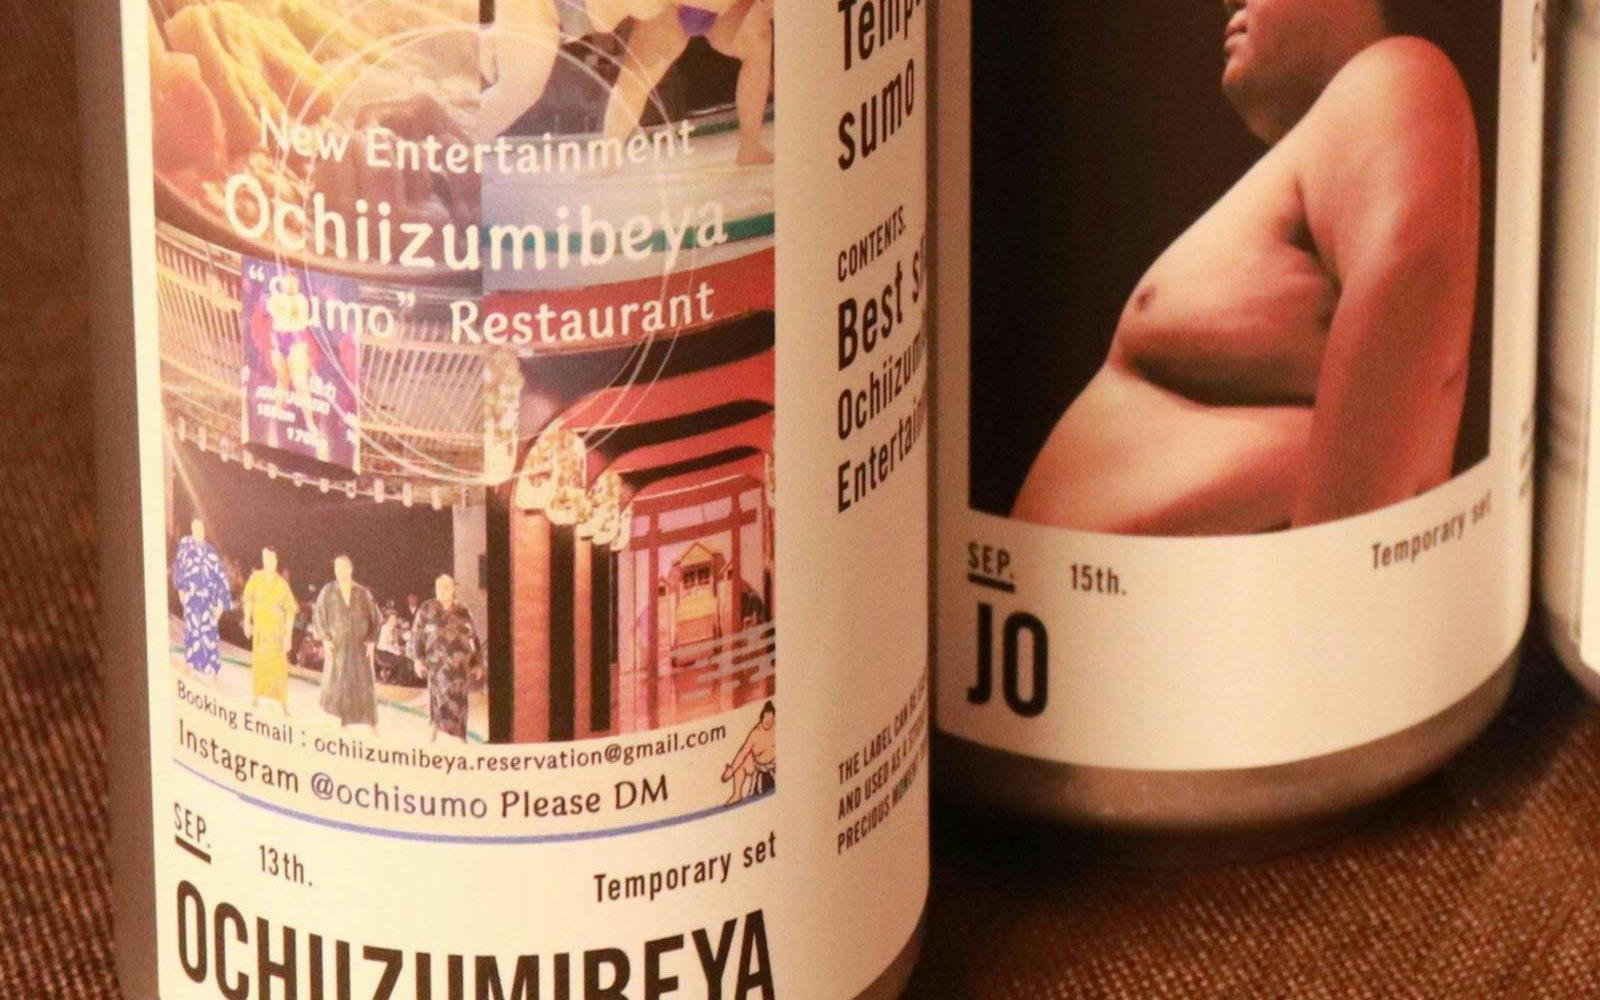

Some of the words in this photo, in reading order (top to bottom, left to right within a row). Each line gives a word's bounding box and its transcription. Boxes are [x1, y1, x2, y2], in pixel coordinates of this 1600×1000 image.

[259, 107, 349, 164] New
[366, 118, 696, 175] Entertainment
[837, 56, 915, 171] sumo
[223, 171, 729, 277] Ochiizumibeya
[450, 281, 715, 346] Restaurant
[837, 258, 904, 372] Best
[967, 540, 1017, 581] SEP.
[1370, 506, 1467, 572] Temporary
[1069, 562, 1128, 597] 15th.
[966, 602, 1050, 720] JO
[176, 678, 239, 731] Booking
[243, 711, 294, 746] Email
[178, 718, 300, 794] Instagram
[310, 771, 488, 819] @ochisumo
[500, 789, 601, 819] Please
[614, 773, 669, 811] DM
[837, 751, 862, 785] THE
[863, 725, 893, 767] LABEL
[836, 786, 862, 821] AND
[864, 759, 890, 801] USED
[172, 800, 213, 849] SEP.
[836, 794, 891, 856] PRECIOUS
[259, 843, 315, 888] 13th.
[593, 851, 733, 904] Temporary
[742, 830, 778, 867] set
